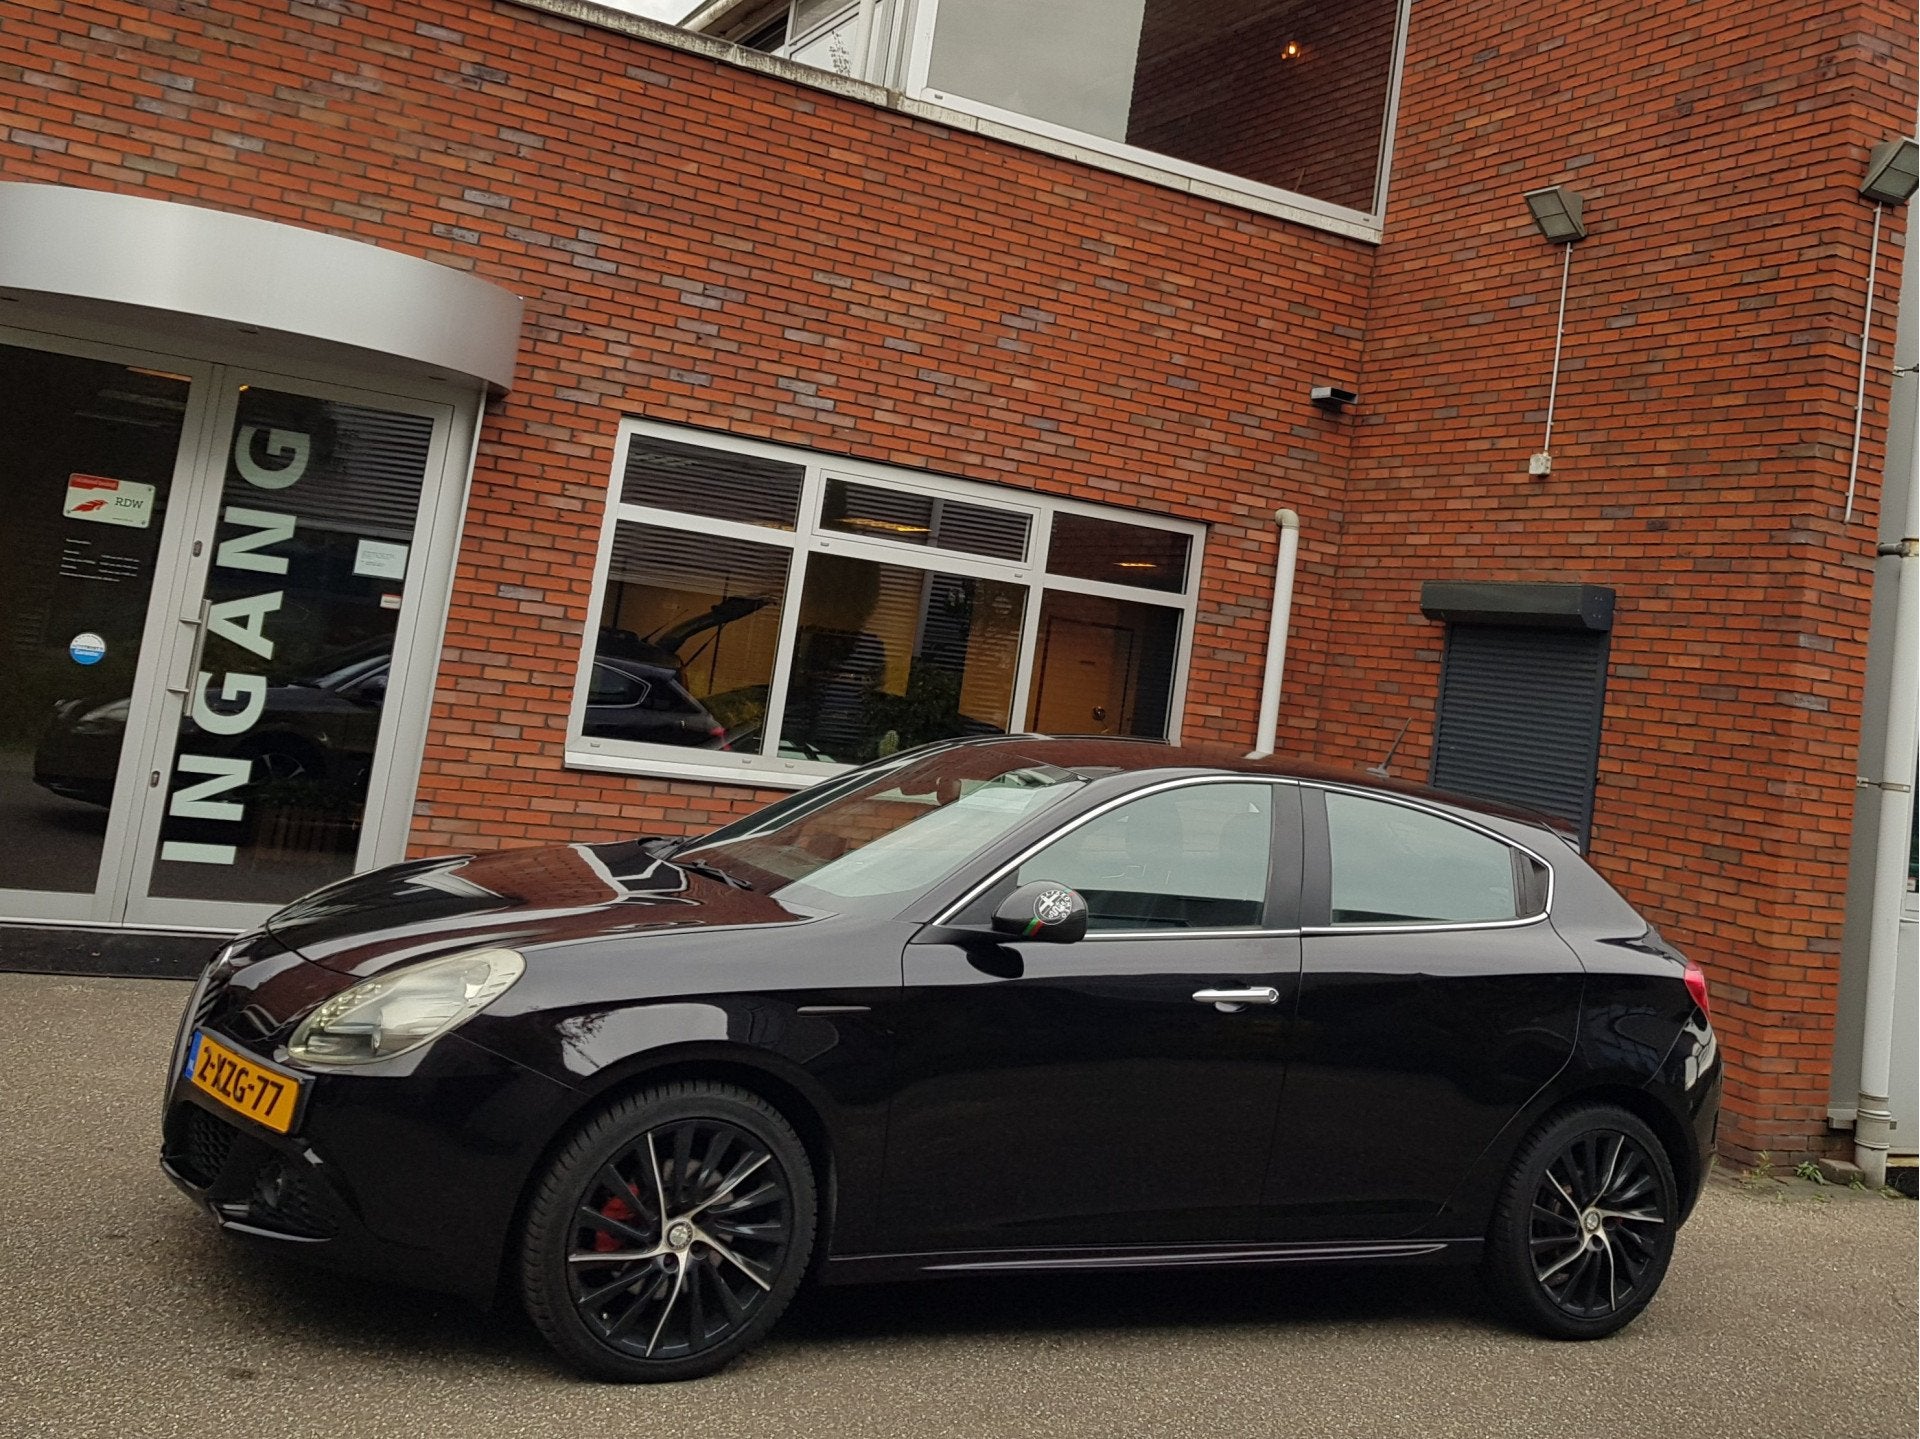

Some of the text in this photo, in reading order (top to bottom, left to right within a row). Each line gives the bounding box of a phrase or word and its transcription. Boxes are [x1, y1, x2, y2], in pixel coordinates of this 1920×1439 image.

[114, 496, 144, 509] RDW
[161, 425, 310, 865] INGANG
[197, 1046, 284, 1117] 2-XZG-77
